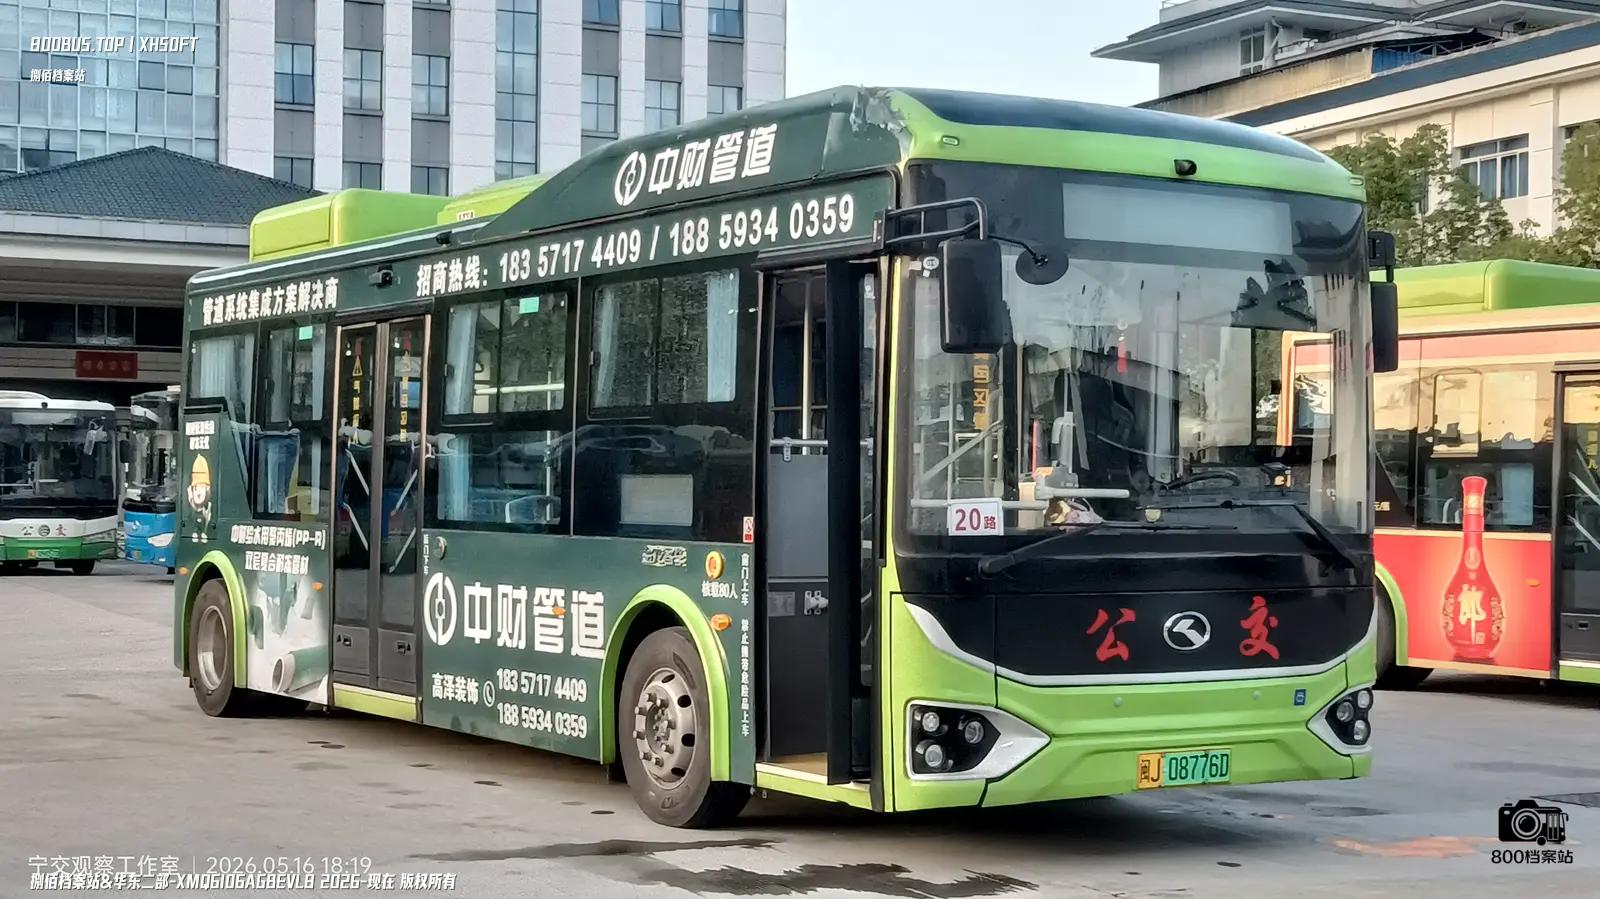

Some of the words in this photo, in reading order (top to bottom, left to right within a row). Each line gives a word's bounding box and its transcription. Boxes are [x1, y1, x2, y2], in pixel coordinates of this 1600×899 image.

[648, 123, 778, 195] 中财管道
[500, 247, 531, 283] 183
[537, 238, 583, 277] 5717
[591, 229, 641, 266] 4409
[669, 216, 708, 258] 188
[719, 206, 778, 250] 5934
[789, 193, 854, 241] 0359
[202, 276, 339, 327] 管道系统集成方案解决商
[701, 580, 738, 599] 核载80人
[463, 581, 607, 660] 中财管道
[1086, 608, 1136, 662] 公
[1239, 596, 1280, 660] 交
[431, 672, 480, 705] 高泽装饰
[496, 668, 518, 692] 183
[521, 671, 551, 697] 5717
[554, 676, 588, 702] 4409
[496, 702, 519, 726] 188
[521, 706, 552, 732] 5934
[554, 712, 588, 739] 0359
